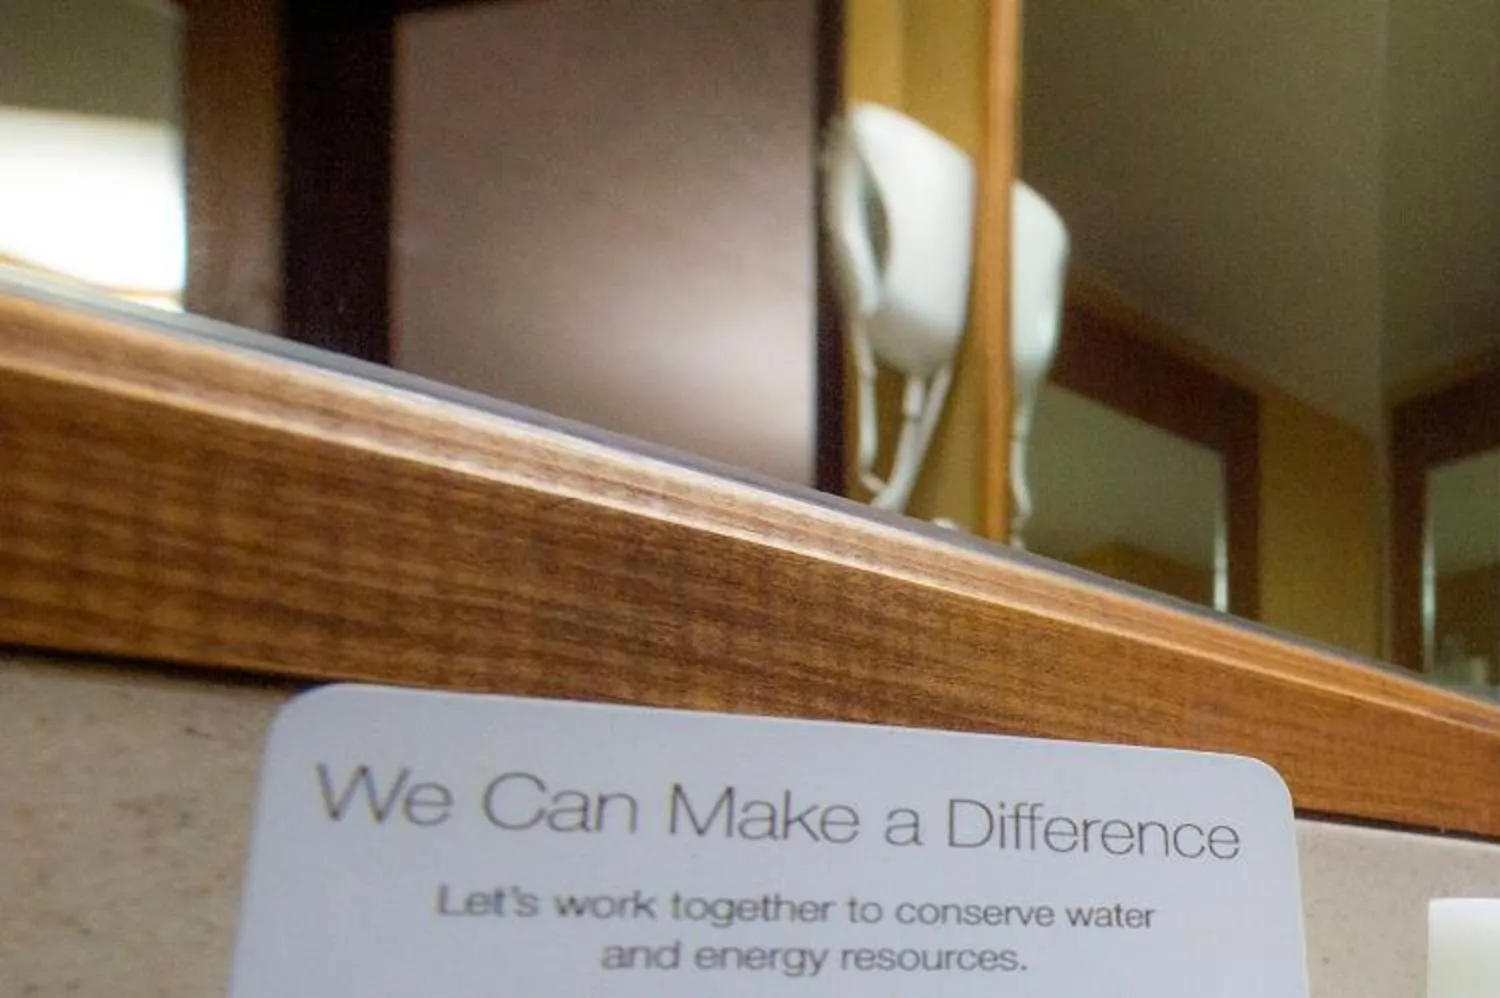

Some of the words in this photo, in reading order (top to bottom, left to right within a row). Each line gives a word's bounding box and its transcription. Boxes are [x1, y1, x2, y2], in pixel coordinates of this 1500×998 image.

[315, 763, 455, 827] We
[481, 771, 639, 834] Can
[668, 782, 861, 844] Make
[884, 808, 924, 847] a
[947, 798, 1240, 860] Difference
[436, 883, 540, 918] Let's
[554, 890, 656, 919] work
[670, 891, 837, 928] together
[846, 896, 884, 924] to
[894, 902, 1056, 928] conserve
[1065, 903, 1156, 929] water
[601, 940, 682, 971] and
[693, 946, 830, 978] energy
[840, 947, 1028, 972] resources.
